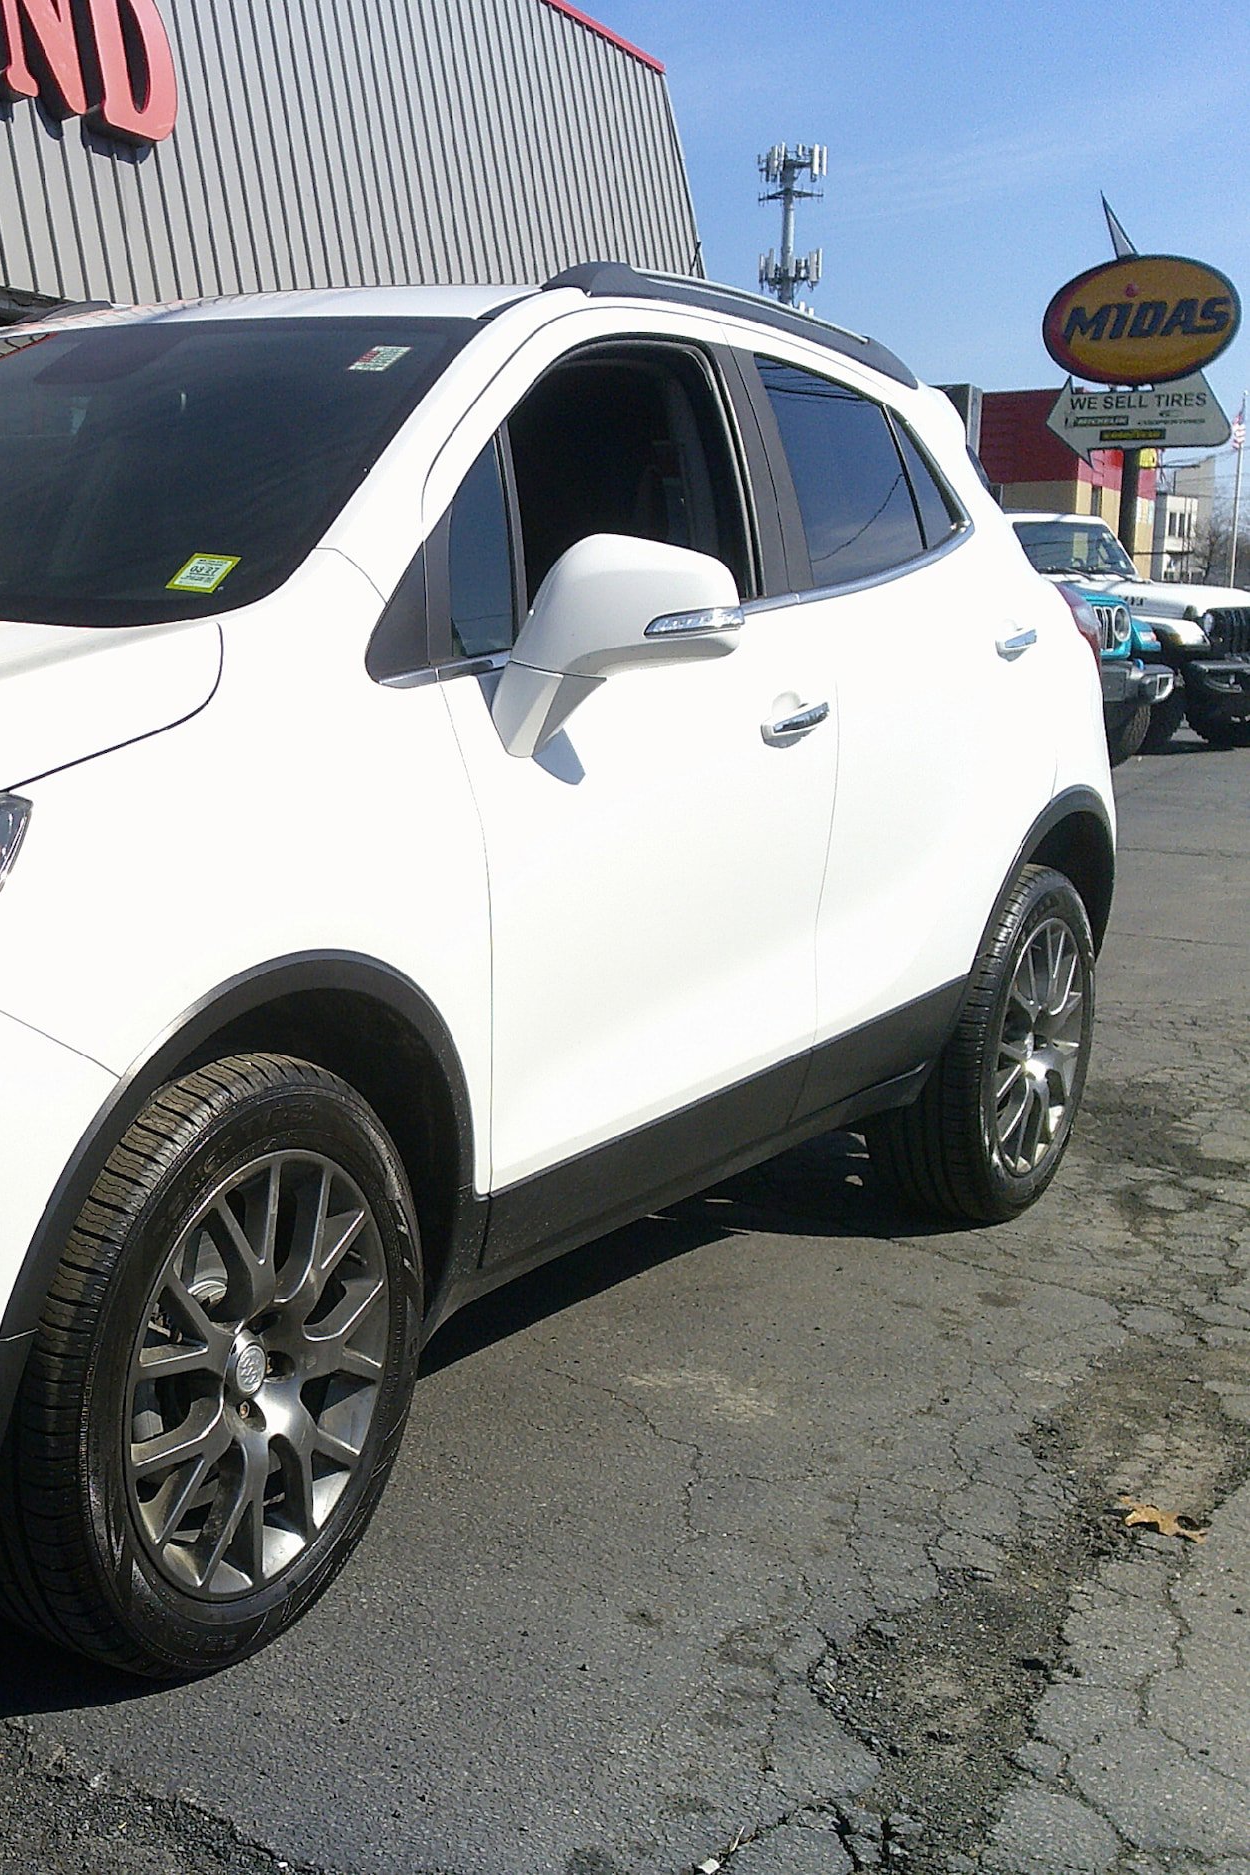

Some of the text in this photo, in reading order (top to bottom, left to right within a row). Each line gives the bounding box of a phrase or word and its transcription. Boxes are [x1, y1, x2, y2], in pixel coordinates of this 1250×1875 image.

[1063, 296, 1231, 345] MIDAS
[1071, 392, 1207, 411] WE SELL TIRES
